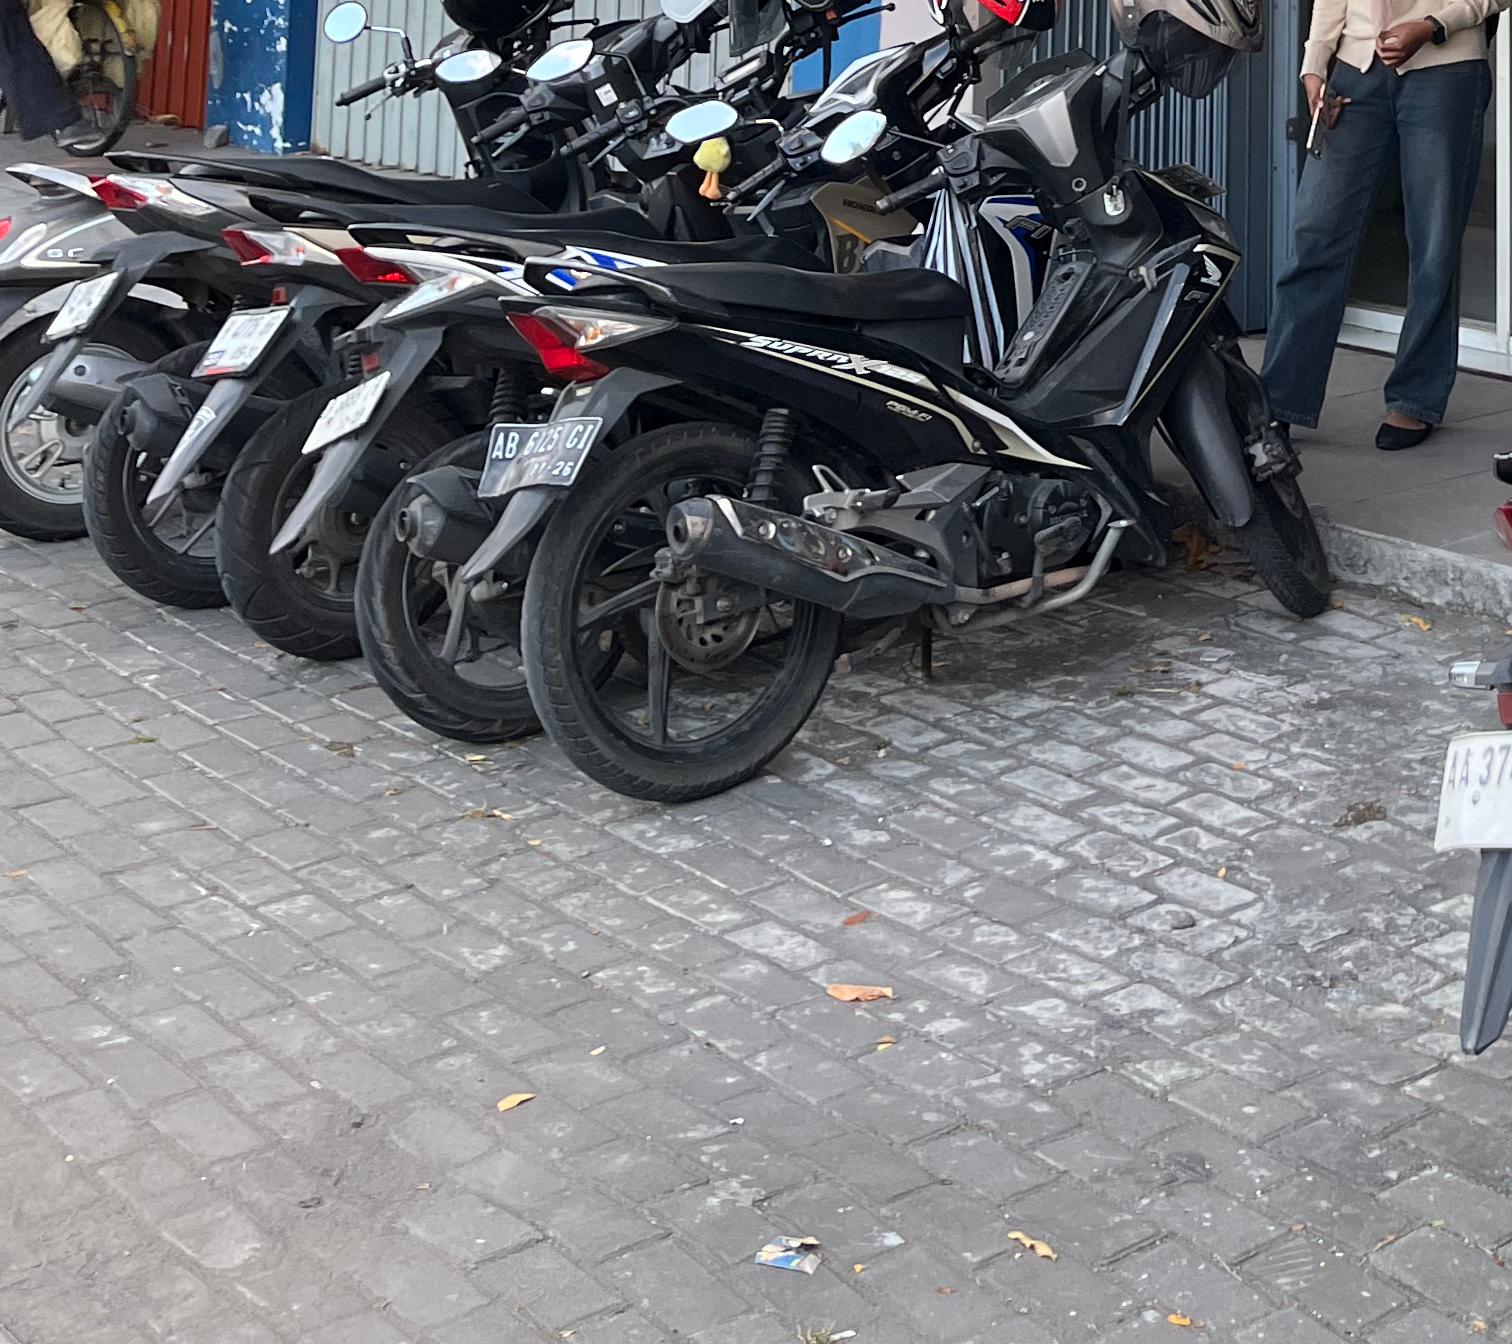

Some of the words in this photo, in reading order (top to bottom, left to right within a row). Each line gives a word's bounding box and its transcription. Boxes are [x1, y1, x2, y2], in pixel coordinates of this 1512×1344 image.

[842, 198, 876, 213] HOND
[491, 431, 520, 460] AB
[1448, 748, 1473, 791] AA
